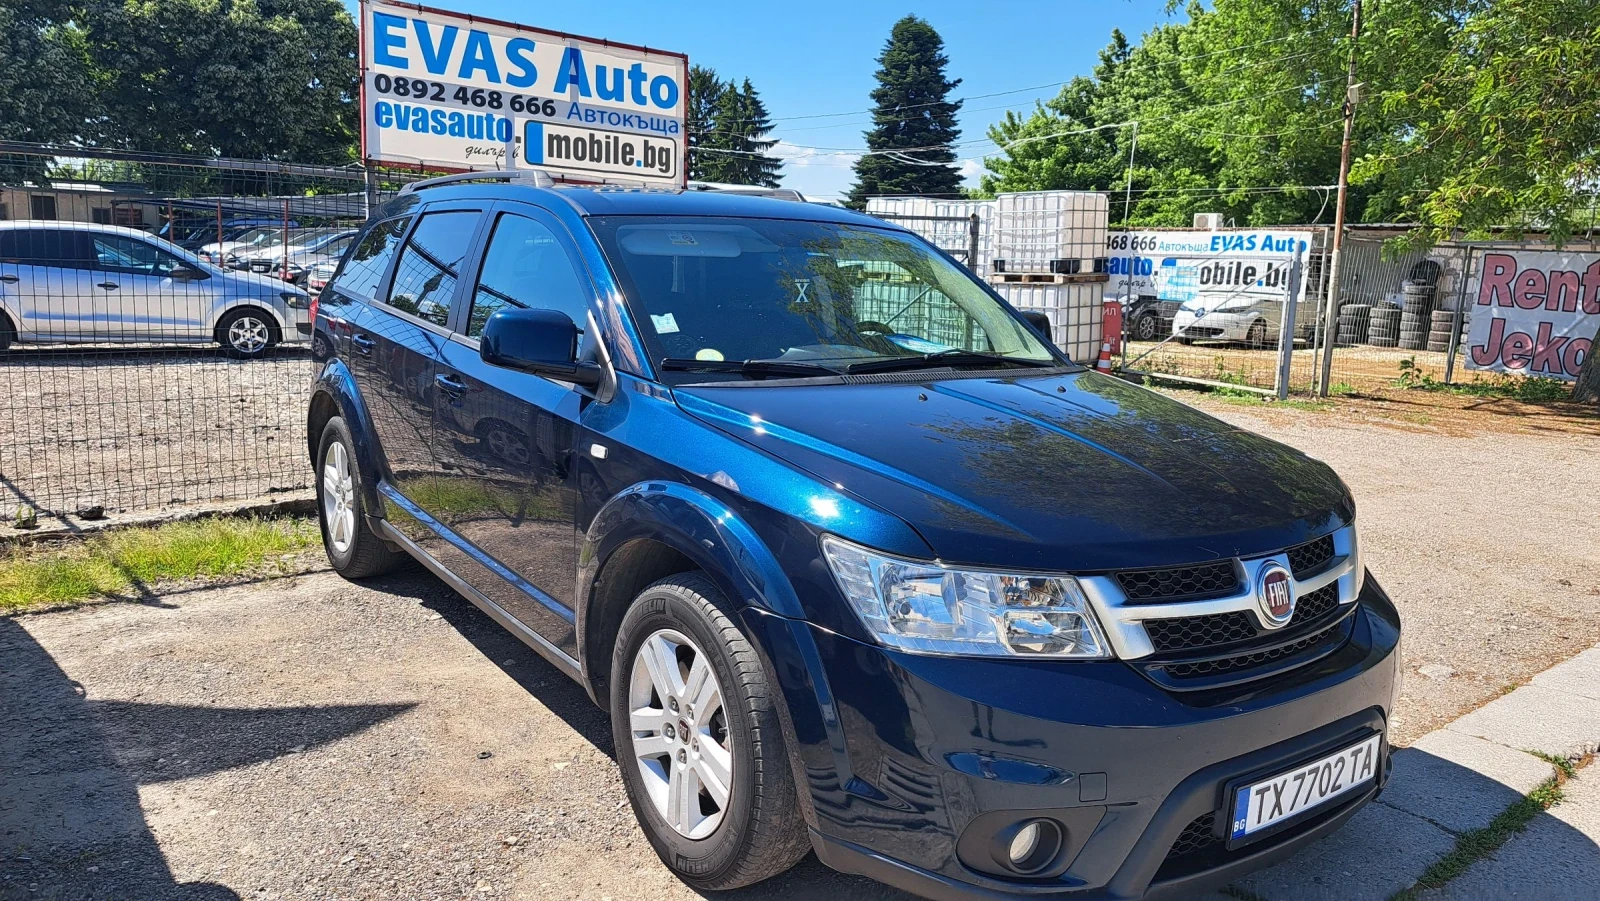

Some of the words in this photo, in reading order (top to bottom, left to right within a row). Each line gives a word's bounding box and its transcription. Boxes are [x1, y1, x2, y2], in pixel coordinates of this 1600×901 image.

[373, 11, 539, 88] EVAS
[553, 47, 679, 110] Auto
[374, 74, 446, 102] 0892
[453, 87, 503, 110] 468
[509, 95, 557, 117] 666
[567, 102, 679, 136] Автокъща
[547, 133, 671, 174] mobile.bg
[1131, 235, 1157, 251] 666
[1210, 234, 1257, 252] EVAS
[1260, 234, 1307, 253] Auto
[1118, 279, 1146, 289] диър
[1477, 253, 1600, 315] Rent
[1268, 580, 1289, 608] FIAT
[1255, 777, 1288, 824] TX
[1289, 756, 1346, 811] 7702
[1350, 743, 1373, 784] TA
[1234, 818, 1246, 832] BG
